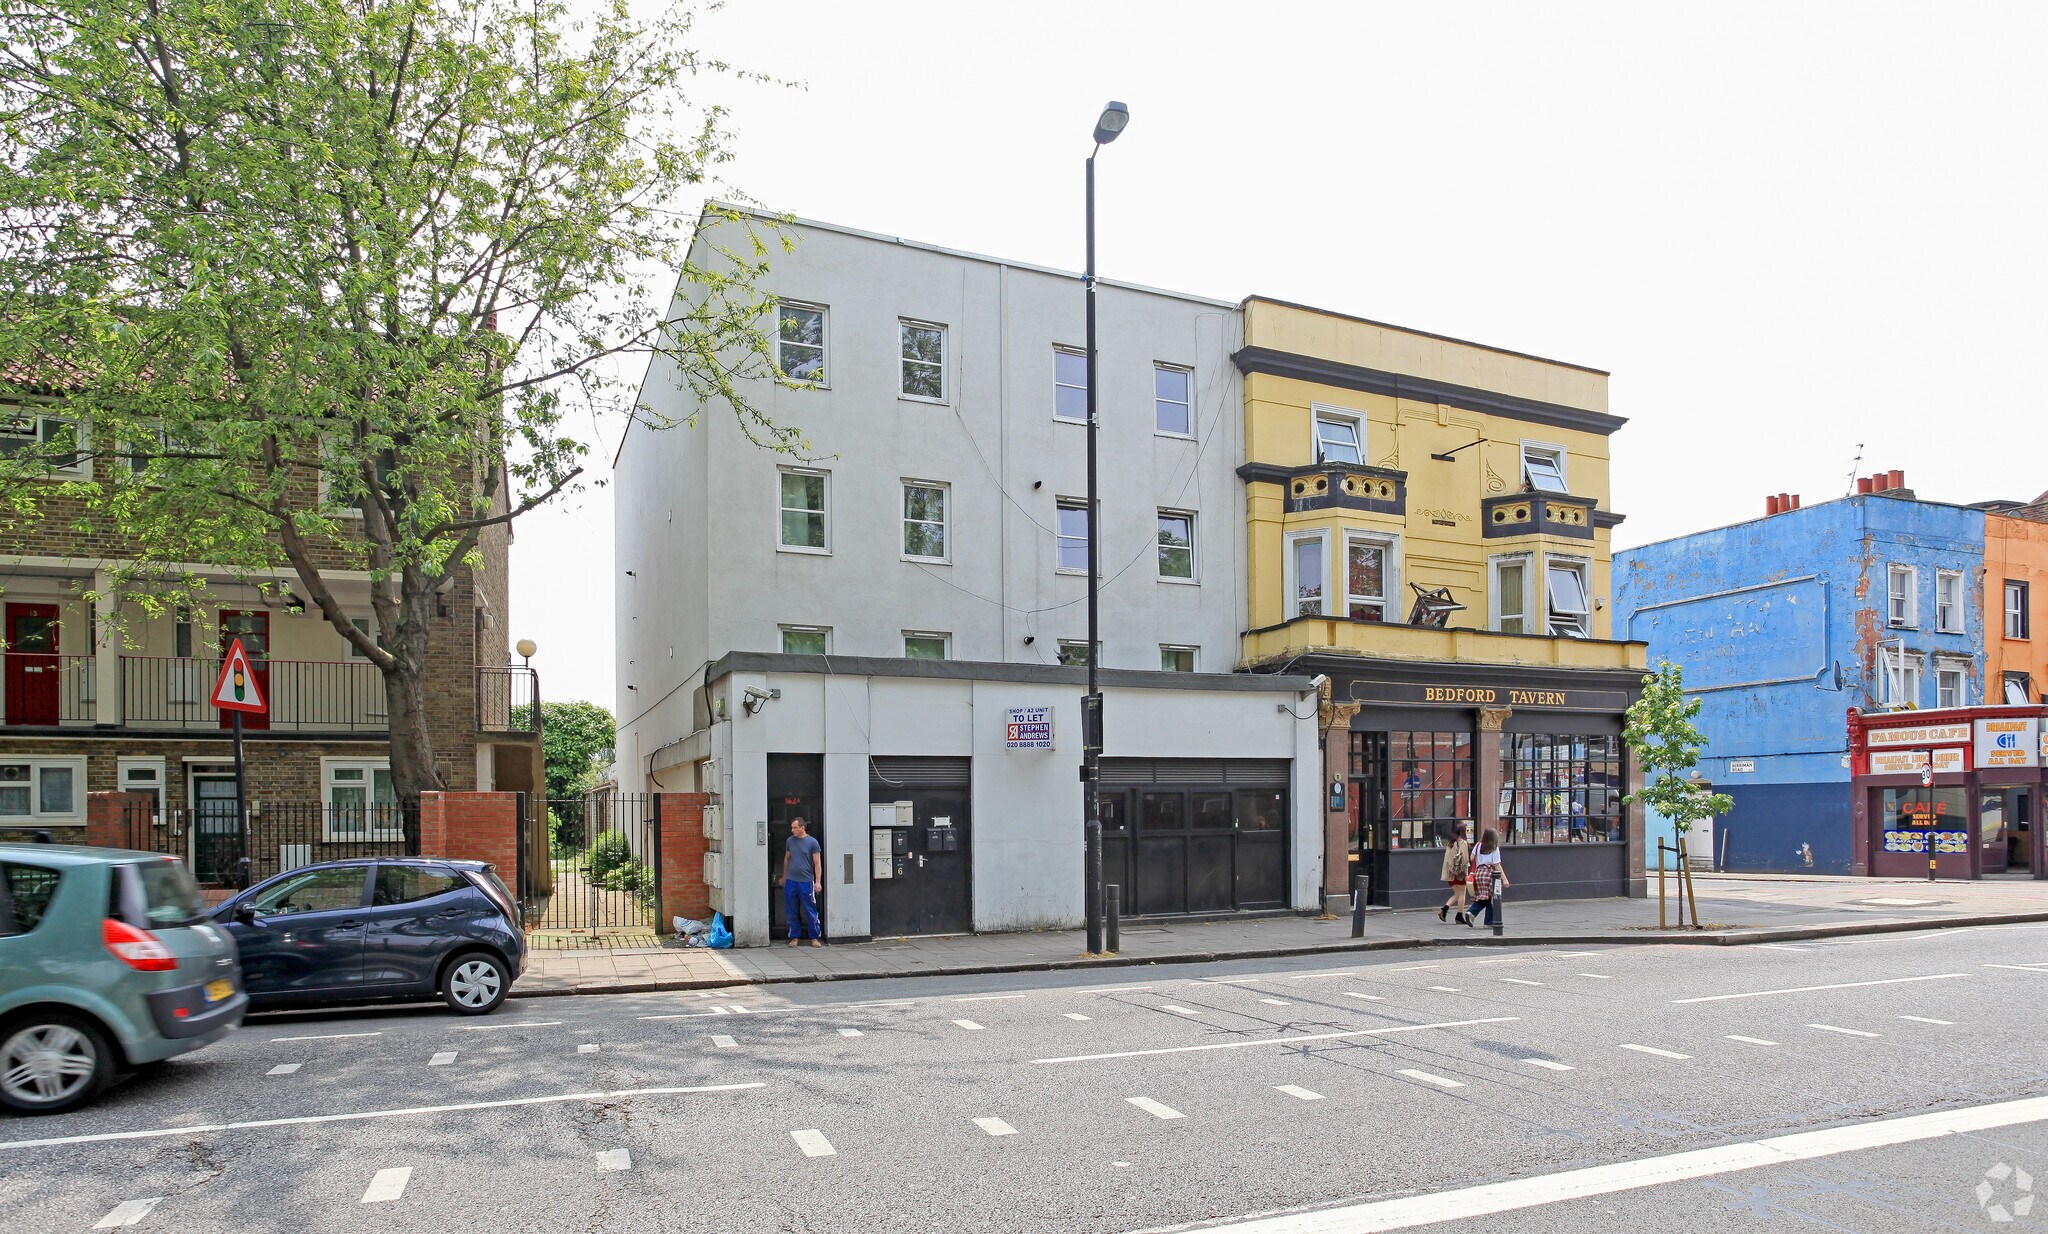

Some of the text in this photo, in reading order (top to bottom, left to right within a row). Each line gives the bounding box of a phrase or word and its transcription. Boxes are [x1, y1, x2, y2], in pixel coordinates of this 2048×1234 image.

[1425, 687, 1566, 705] BEDFORD TAVERN
[1013, 713, 1044, 722] TO LET
[1986, 721, 2027, 732] BREAKFAST
[1020, 732, 1049, 740] ANDREWS
[1871, 727, 1968, 742] FAMOUS CAFE
[1990, 749, 2025, 757] SERVED
[1875, 755, 1909, 764] BREAKFAST
[1935, 753, 1960, 762] DINNER
[1988, 757, 2004, 765] ALL
[1921, 768, 1931, 780] 30
[897, 867, 903, 875] 6
